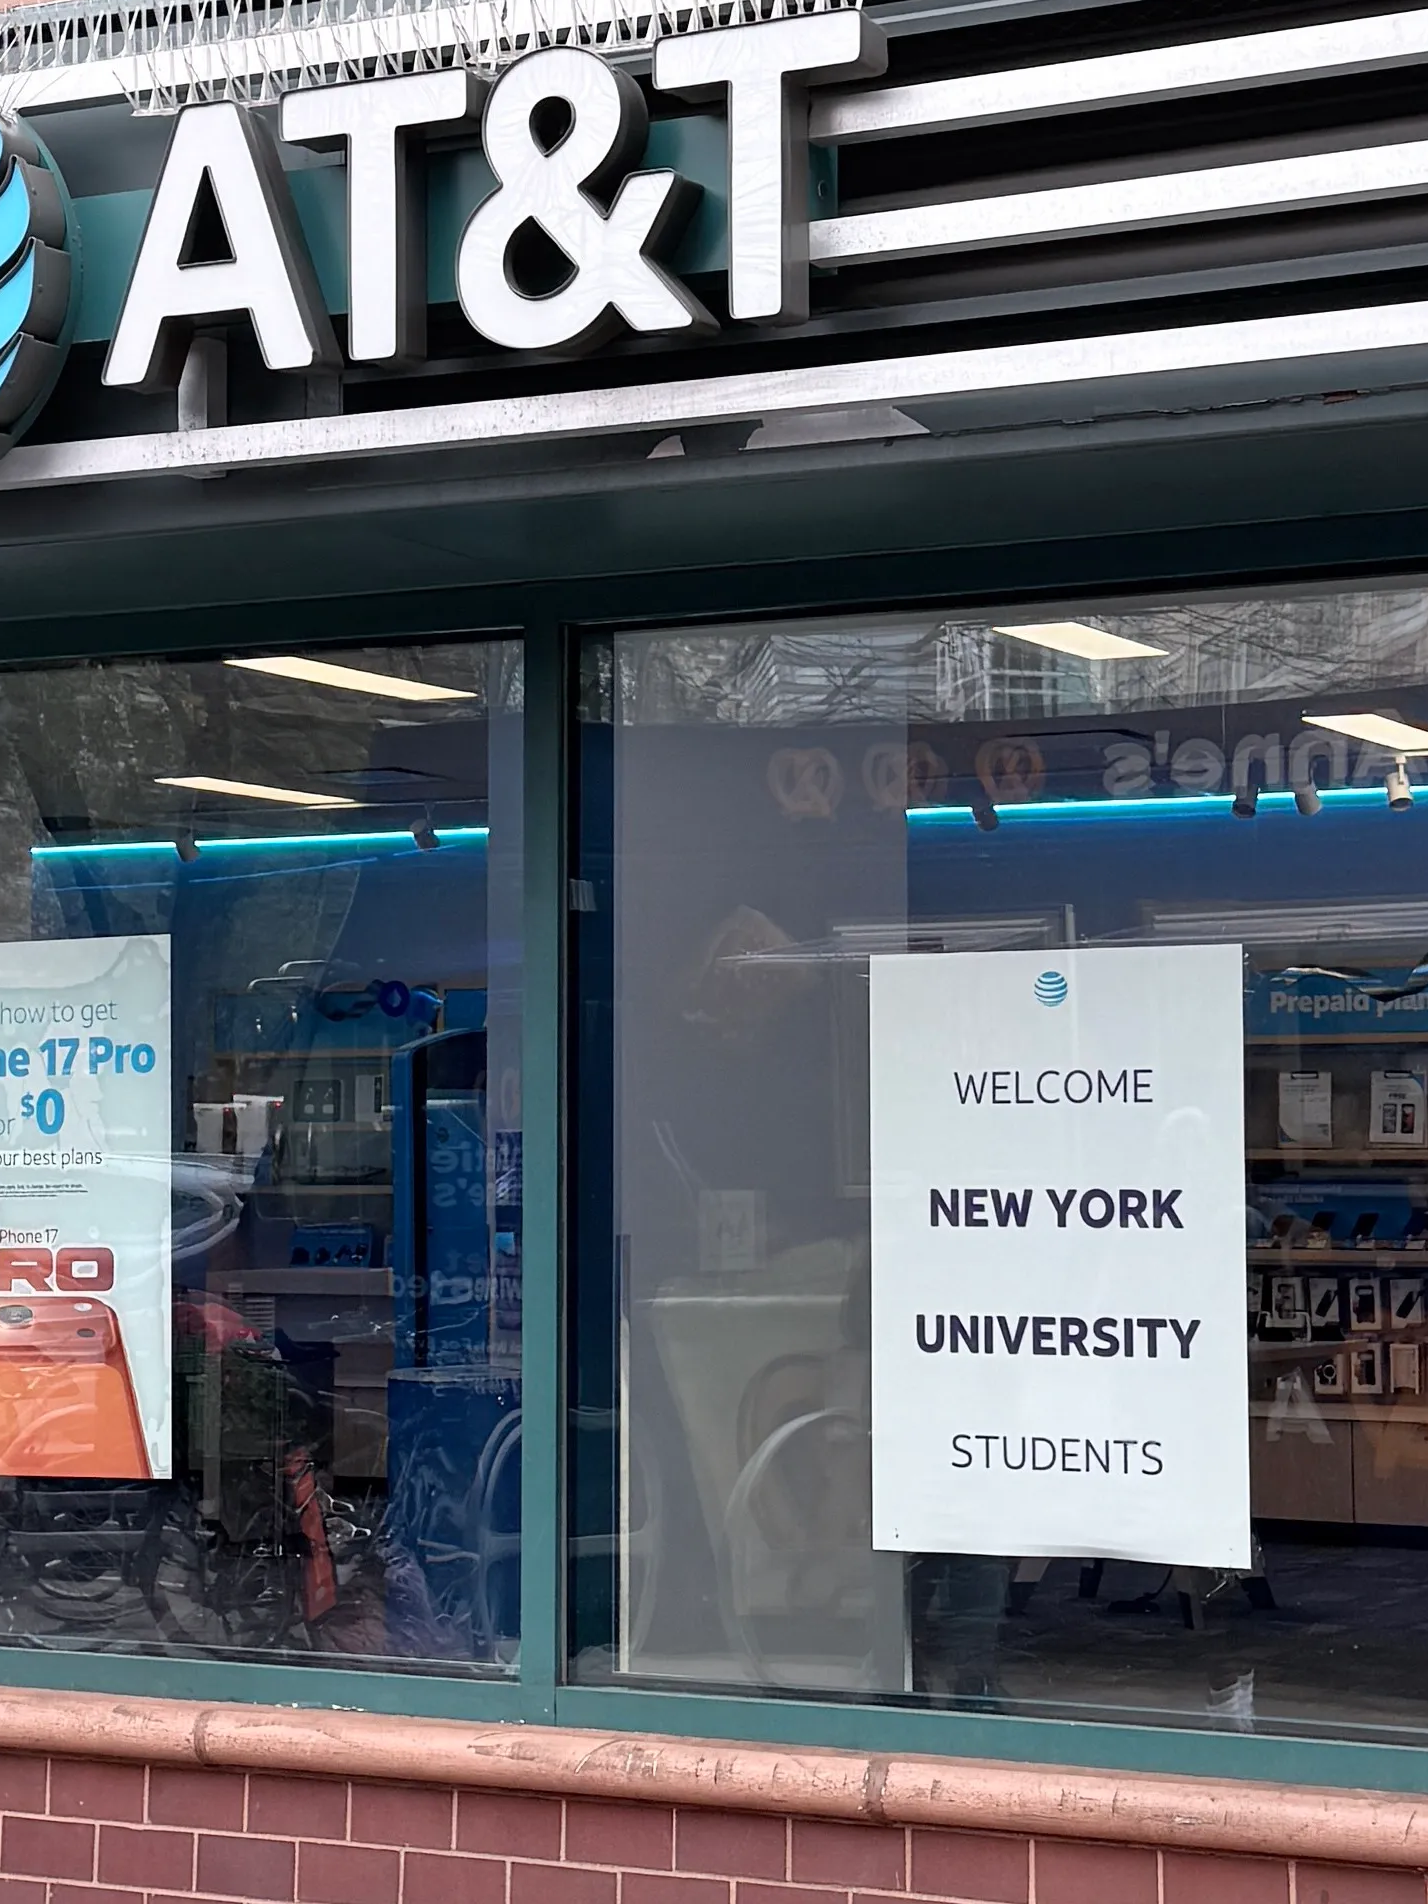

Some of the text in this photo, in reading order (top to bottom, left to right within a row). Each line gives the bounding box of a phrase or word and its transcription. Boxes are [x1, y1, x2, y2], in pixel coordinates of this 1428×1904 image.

[102, 7, 885, 388] AT&T
[0, 1001, 45, 1025] how
[51, 1001, 75, 1023] to
[81, 1000, 119, 1028] get
[1270, 989, 1371, 1018] Prepaid
[38, 1037, 81, 1077] 17
[88, 1036, 156, 1075] Pro
[953, 1068, 1154, 1105] WELCOME
[20, 1088, 65, 1135] $0
[23, 1148, 57, 1166] best
[61, 1147, 103, 1170] plans
[929, 1187, 1184, 1229] NEW YORK
[44, 1229, 59, 1244] 17
[916, 1313, 1201, 1360] UNIVERSITY
[951, 1433, 1164, 1476] STUDENTS
